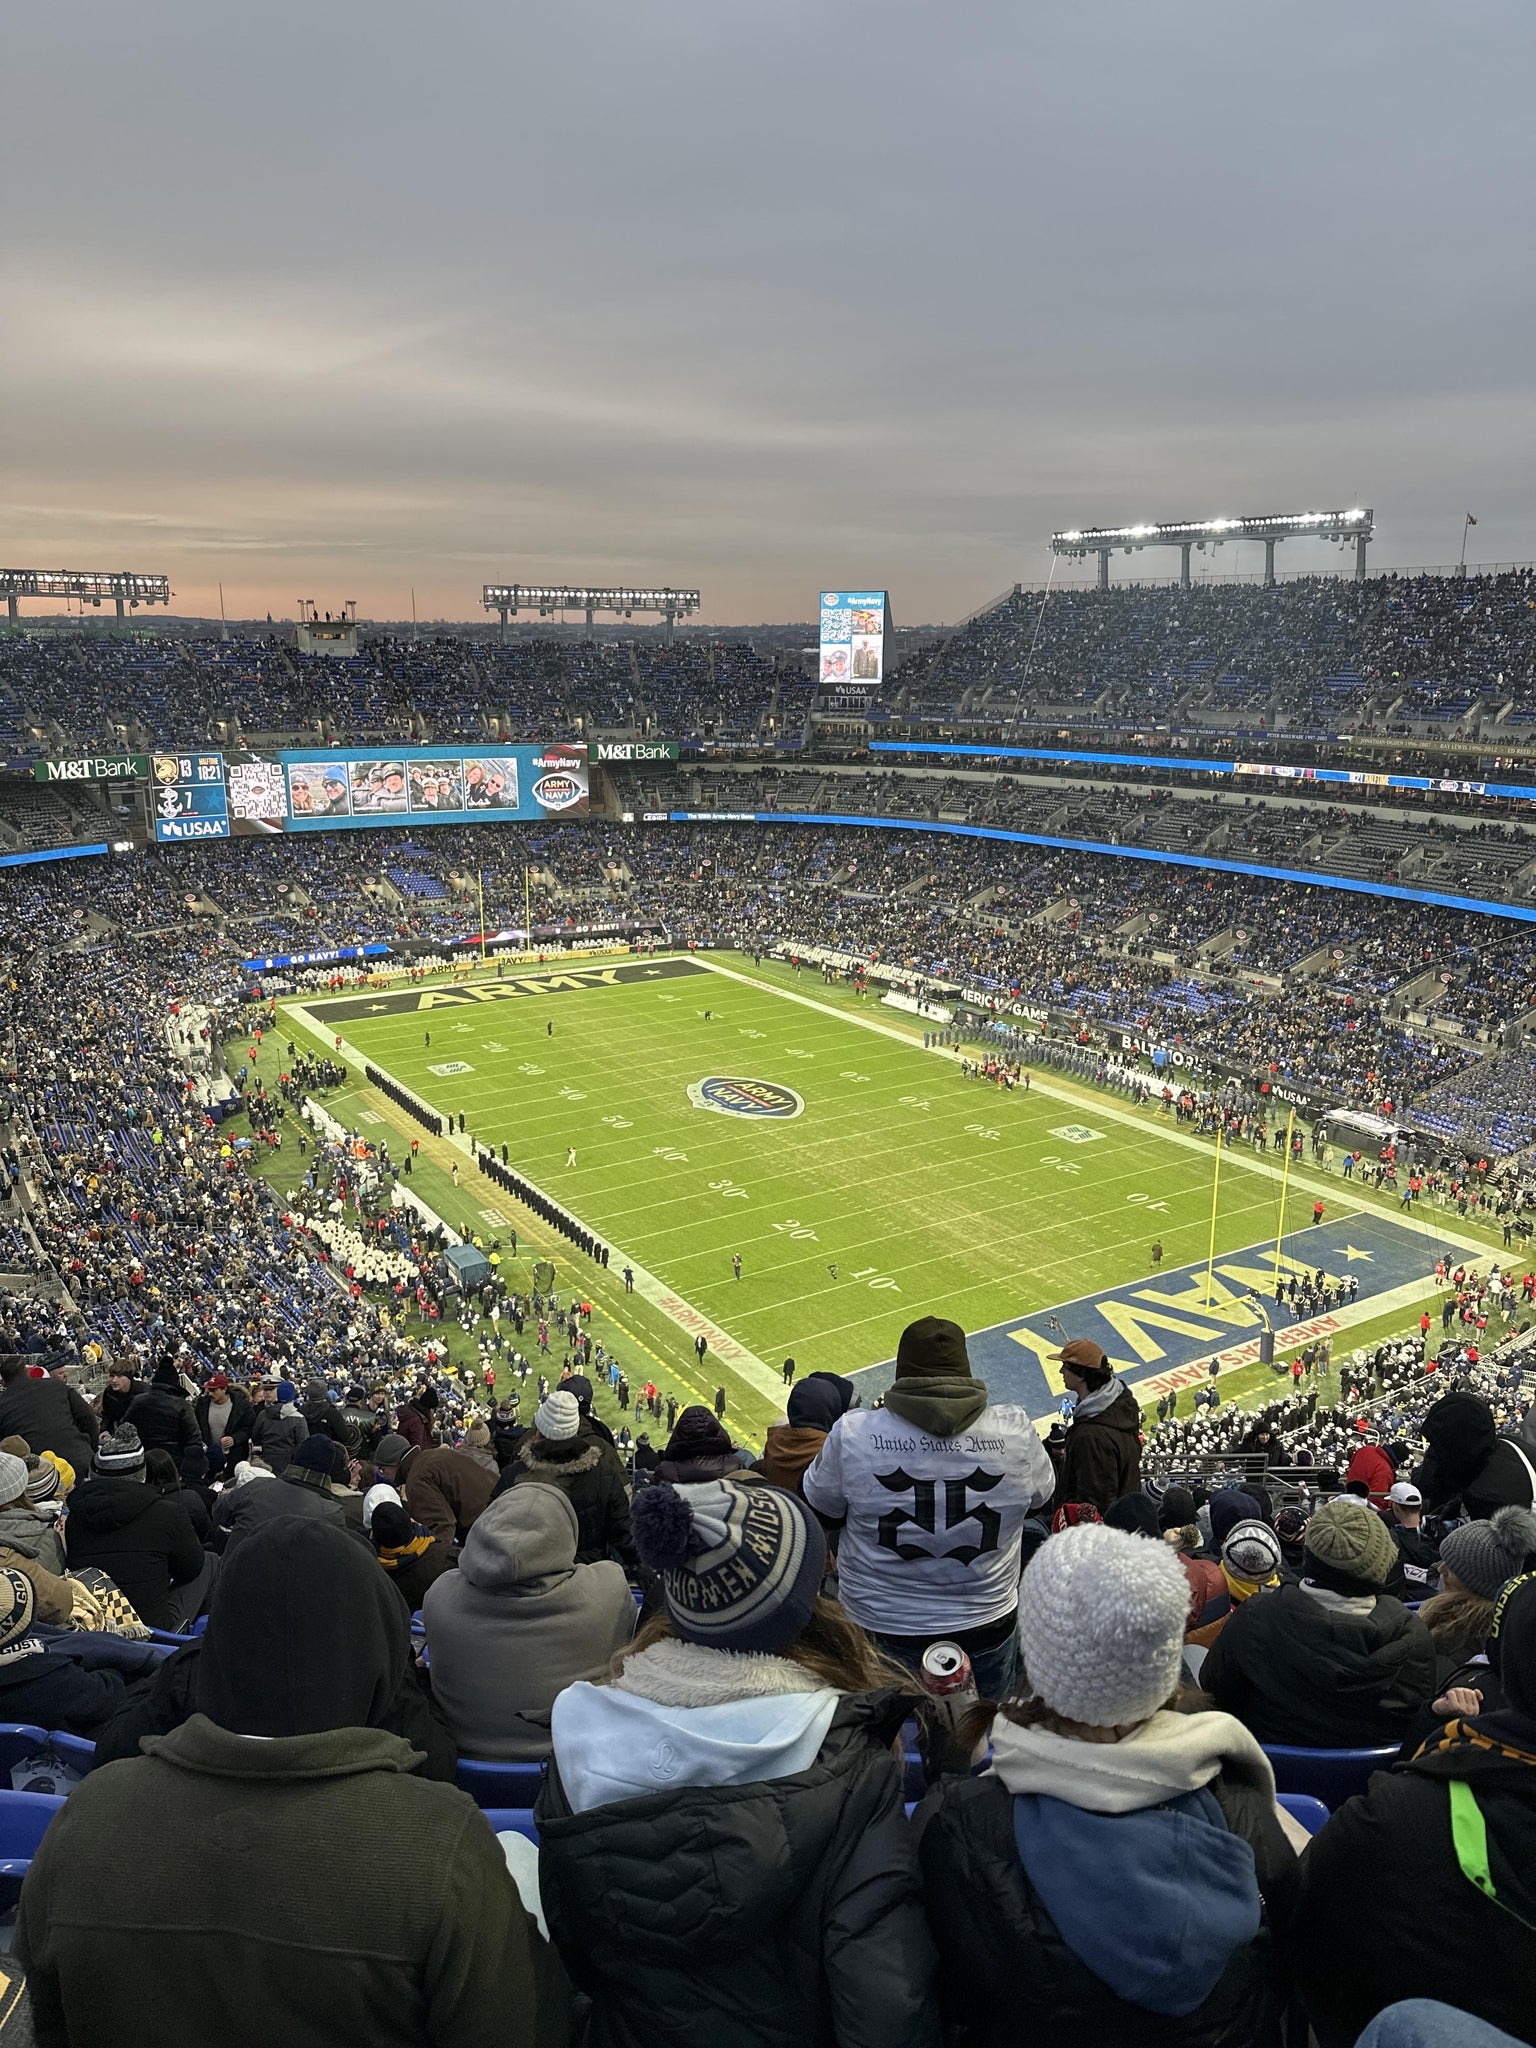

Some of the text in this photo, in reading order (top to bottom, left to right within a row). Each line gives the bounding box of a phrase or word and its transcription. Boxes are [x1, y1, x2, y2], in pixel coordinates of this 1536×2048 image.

[846, 686, 867, 695] USAA
[1360, 737, 1385, 745] JONATHAN
[1386, 739, 1404, 747] OGDEN
[1468, 745, 1497, 753] 1996-2012
[597, 743, 671, 760] M&T Bank
[46, 758, 138, 780] M&T Bank
[179, 759, 193, 778] 13
[532, 757, 581, 769] #ArmyNavy
[198, 765, 221, 781] 18:21
[543, 780, 571, 788] ARMY
[184, 791, 193, 810] 7
[545, 791, 571, 800] NAVY
[643, 813, 668, 822] LEGION
[712, 813, 740, 822] Army-Navy
[183, 820, 224, 837] USAA
[576, 922, 620, 934] GO ARMY!
[290, 950, 340, 965] GO NAVY!
[431, 963, 458, 975] ARMY
[417, 969, 623, 1010] ARMY
[1012, 1003, 1049, 1021] GAME
[518, 1062, 546, 1076] 30
[839, 1071, 871, 1084] 50
[558, 1086, 588, 1101] 40
[707, 1087, 764, 1110] NAVY
[734, 1082, 793, 1104] ARMY
[1283, 1090, 1308, 1105] USAA
[898, 1096, 928, 1110] 40
[602, 1114, 634, 1129] 50
[964, 1124, 1001, 1140] 30
[653, 1145, 687, 1161] 40
[1040, 1156, 1083, 1173] 20
[708, 1179, 746, 1198] 30
[1126, 1193, 1172, 1212] 10
[772, 1219, 815, 1240] 20
[850, 1266, 896, 1290] 10
[659, 1297, 748, 1360] #ARMYNAVY
[1006, 1250, 1345, 1397] NAVY
[1144, 1316, 1341, 1395] AMERIA'S GAME
[870, 1434, 1006, 1455] United States Army
[872, 1465, 1006, 1568] 25
[13, 1580, 27, 1605] GO
[1491, 1573, 1529, 1639] UNDER
